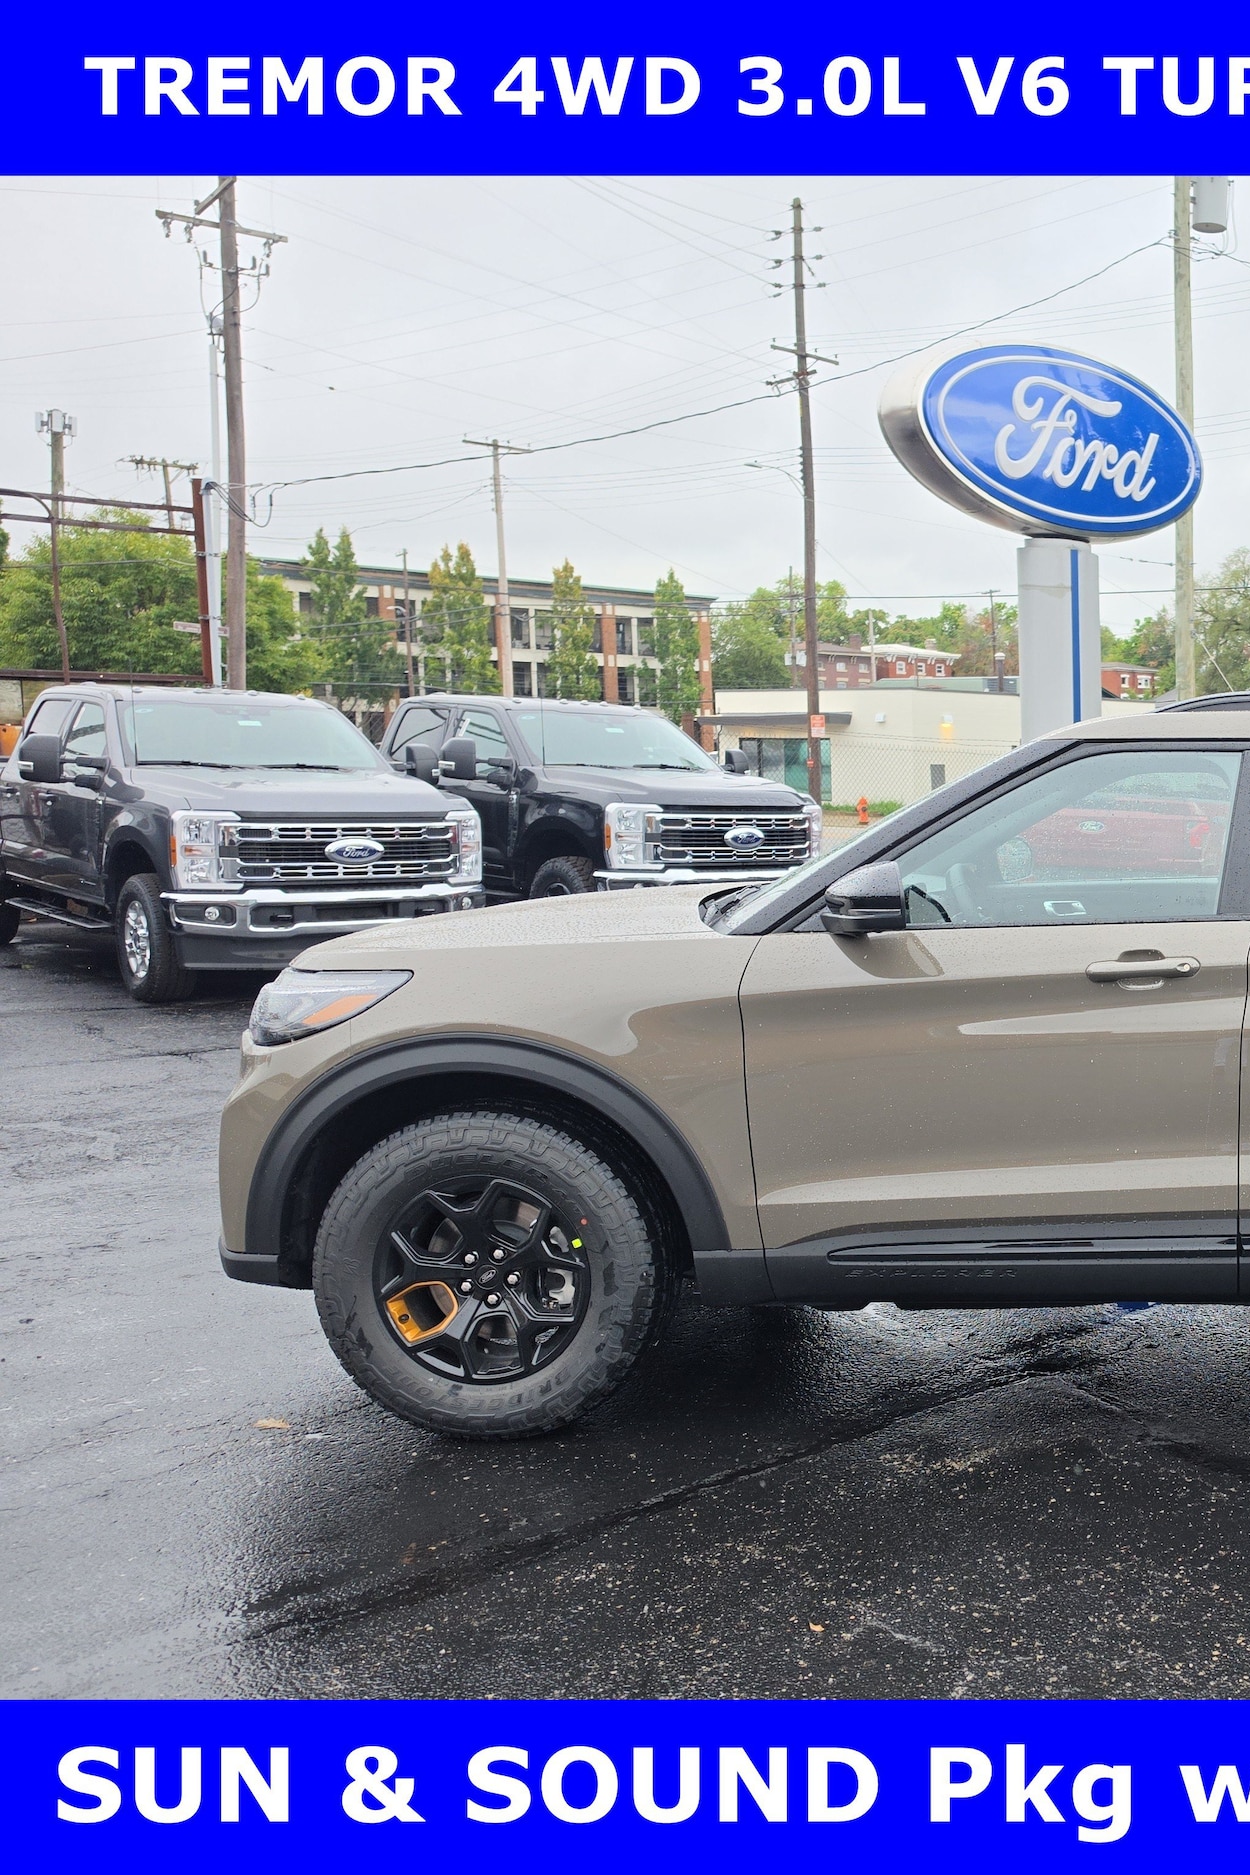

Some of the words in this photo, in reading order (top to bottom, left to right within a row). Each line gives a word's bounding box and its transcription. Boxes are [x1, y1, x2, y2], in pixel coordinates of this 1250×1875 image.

[995, 376, 1159, 501] Ford
[342, 845, 370, 857] Ford
[845, 1267, 1018, 1279] EXPLORER
